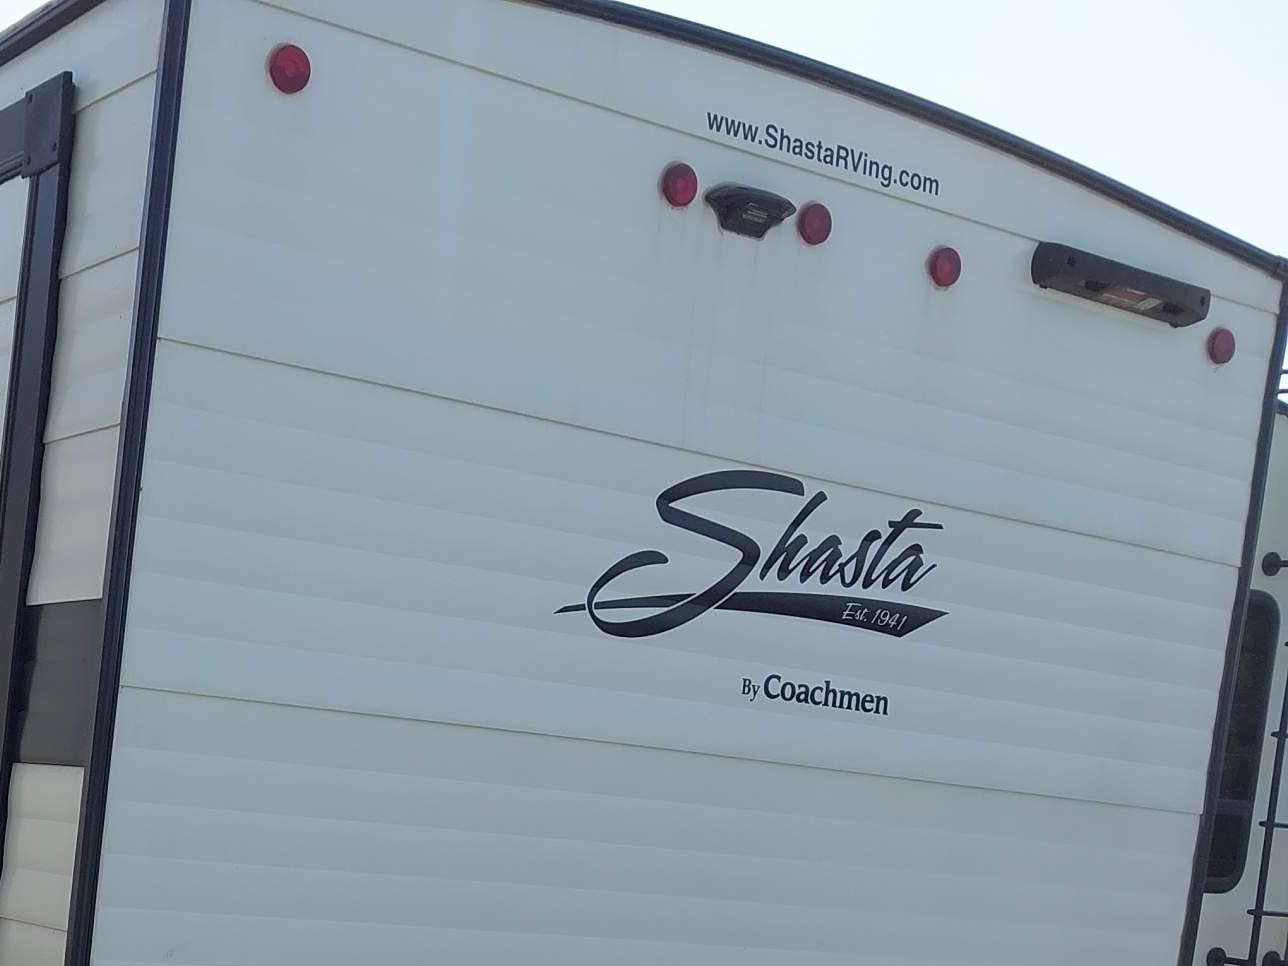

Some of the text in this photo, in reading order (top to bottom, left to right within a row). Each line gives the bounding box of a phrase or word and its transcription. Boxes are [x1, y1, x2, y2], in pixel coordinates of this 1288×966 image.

[706, 111, 940, 196] www.ShastaRVing.com
[585, 470, 944, 638] Shasta
[841, 602, 908, 631] Est. 1941
[741, 673, 889, 716] By Coachmen
